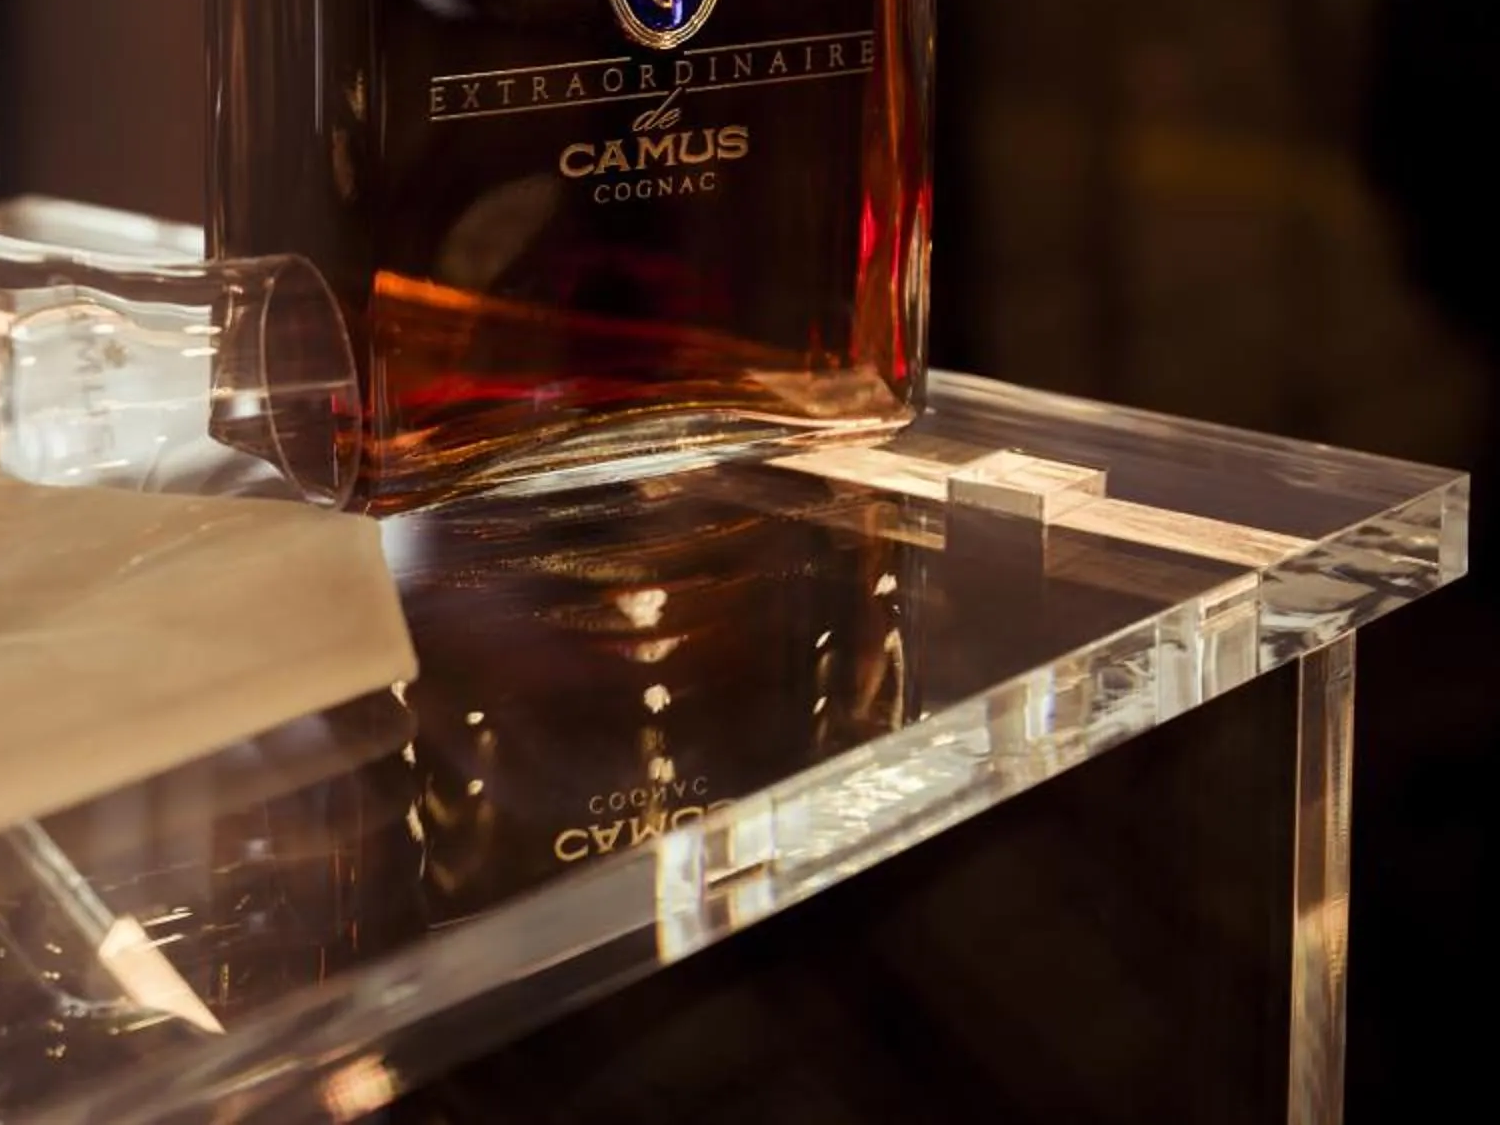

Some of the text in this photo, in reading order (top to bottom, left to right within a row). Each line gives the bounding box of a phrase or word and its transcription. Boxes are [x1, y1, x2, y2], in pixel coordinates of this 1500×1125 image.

[430, 41, 875, 113] EXTRAORDINAIRE
[631, 86, 683, 132] de
[558, 125, 749, 178] CAMUS
[593, 172, 716, 204] COGNAC
